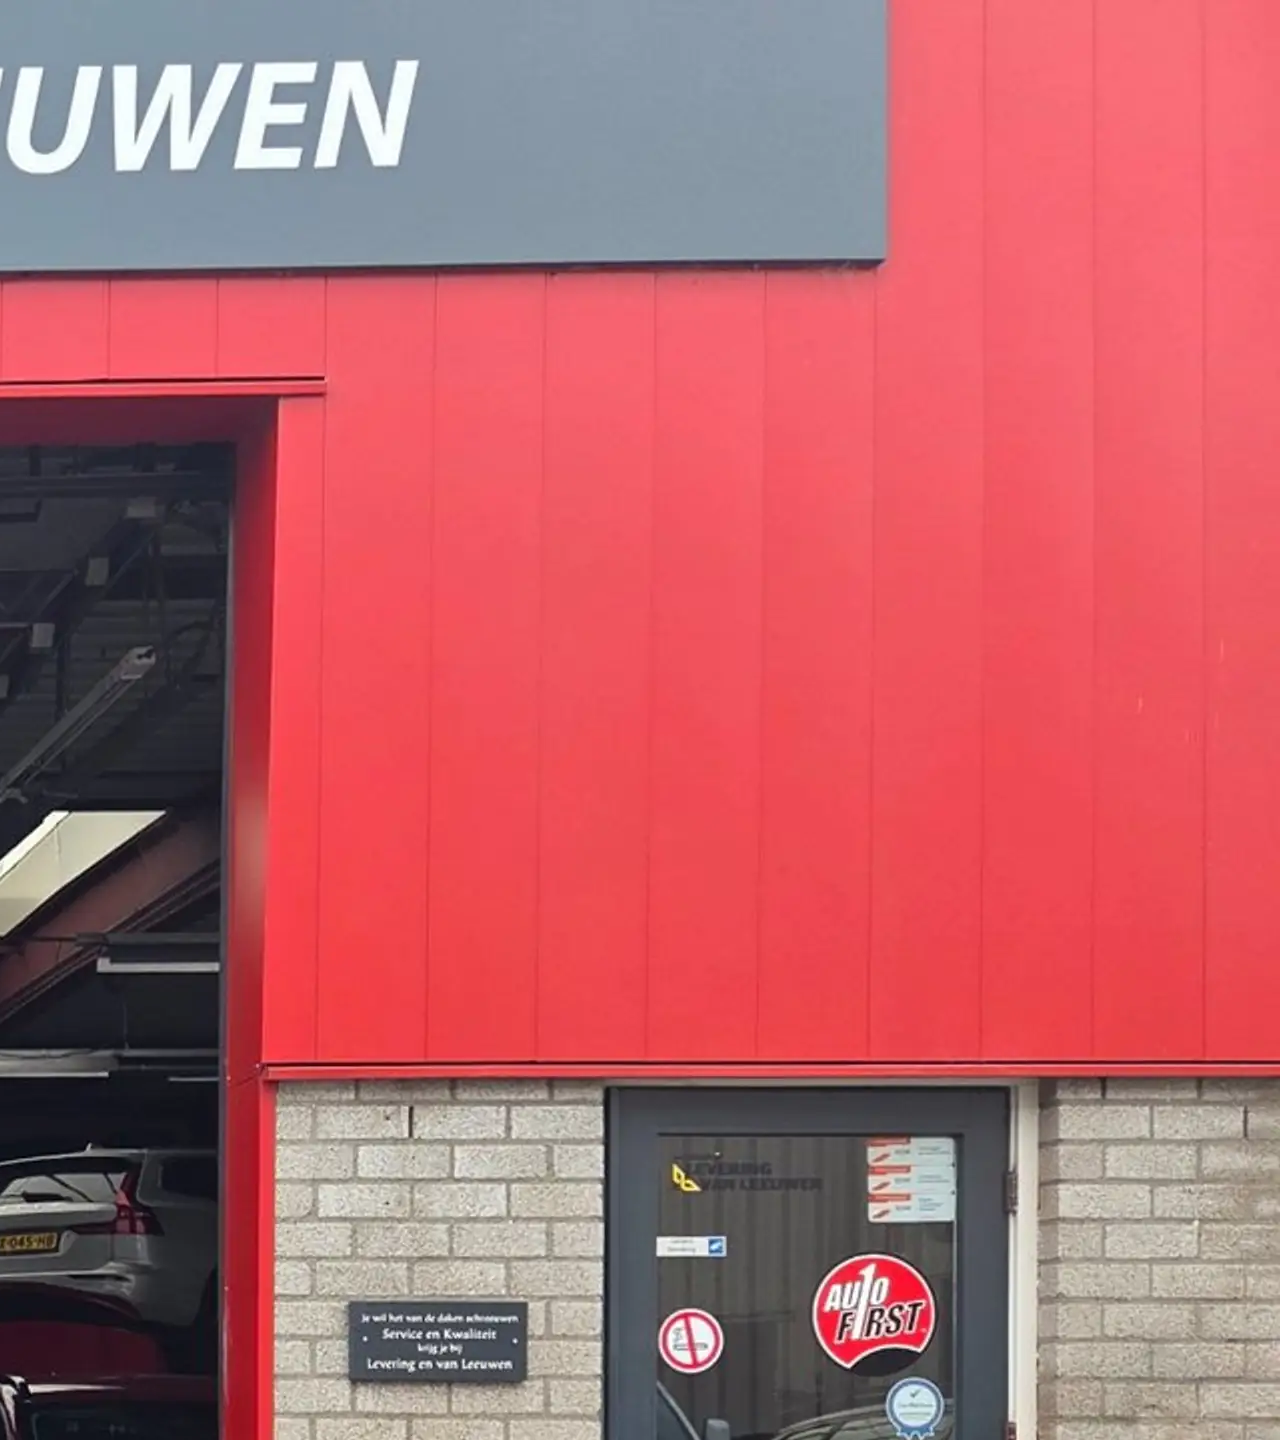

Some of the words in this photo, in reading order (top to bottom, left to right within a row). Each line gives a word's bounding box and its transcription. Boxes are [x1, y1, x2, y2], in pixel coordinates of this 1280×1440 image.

[833, 1299, 927, 1344] FIRST
[382, 1327, 424, 1340] Service
[426, 1330, 441, 1340] en
[444, 1327, 497, 1340] Kwaliteit
[367, 1358, 416, 1373] Levering
[418, 1360, 434, 1370] en
[436, 1360, 459, 1370] van
[461, 1358, 513, 1370] Leeuwen
